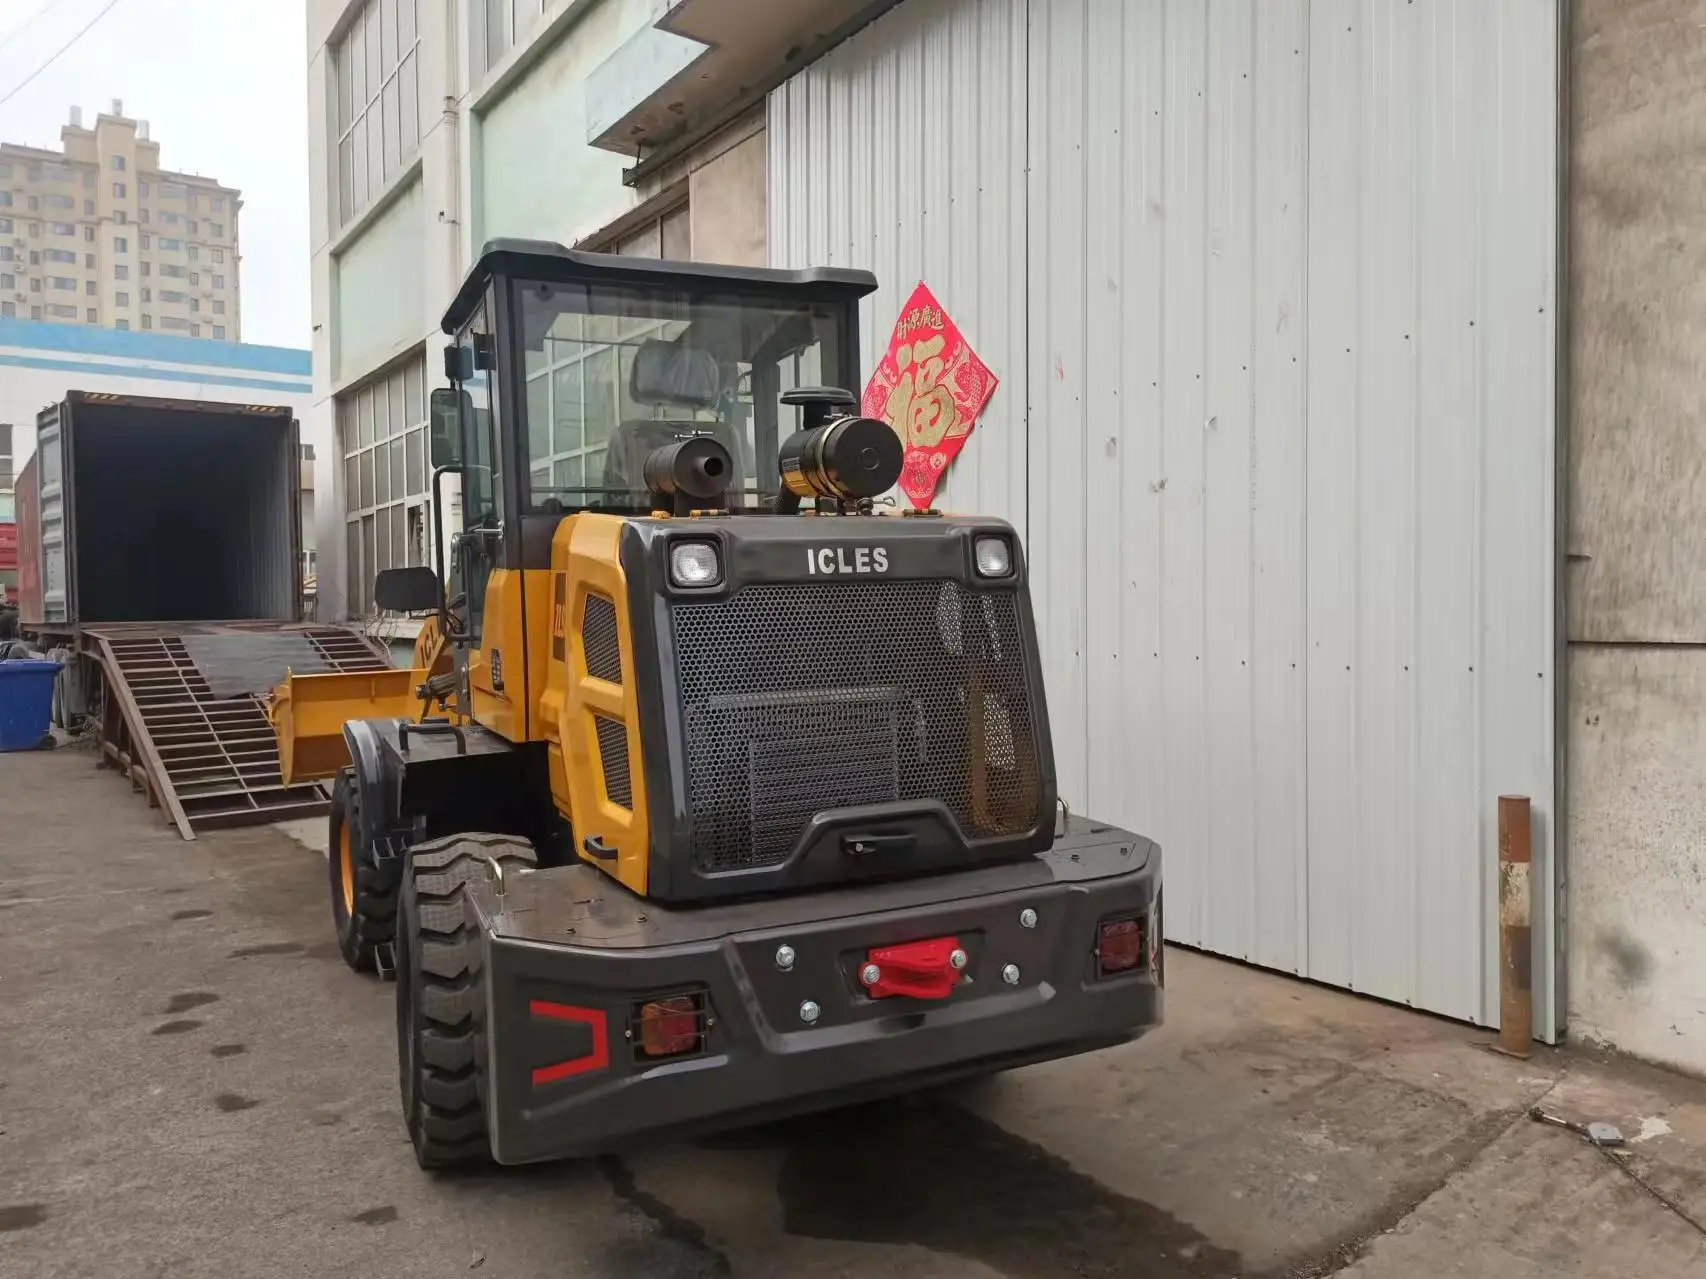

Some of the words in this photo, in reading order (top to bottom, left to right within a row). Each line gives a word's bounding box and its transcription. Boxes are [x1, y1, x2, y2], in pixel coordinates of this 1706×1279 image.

[885, 333, 956, 453] 福
[807, 547, 889, 575] ICLES
[420, 620, 440, 669] ICL
